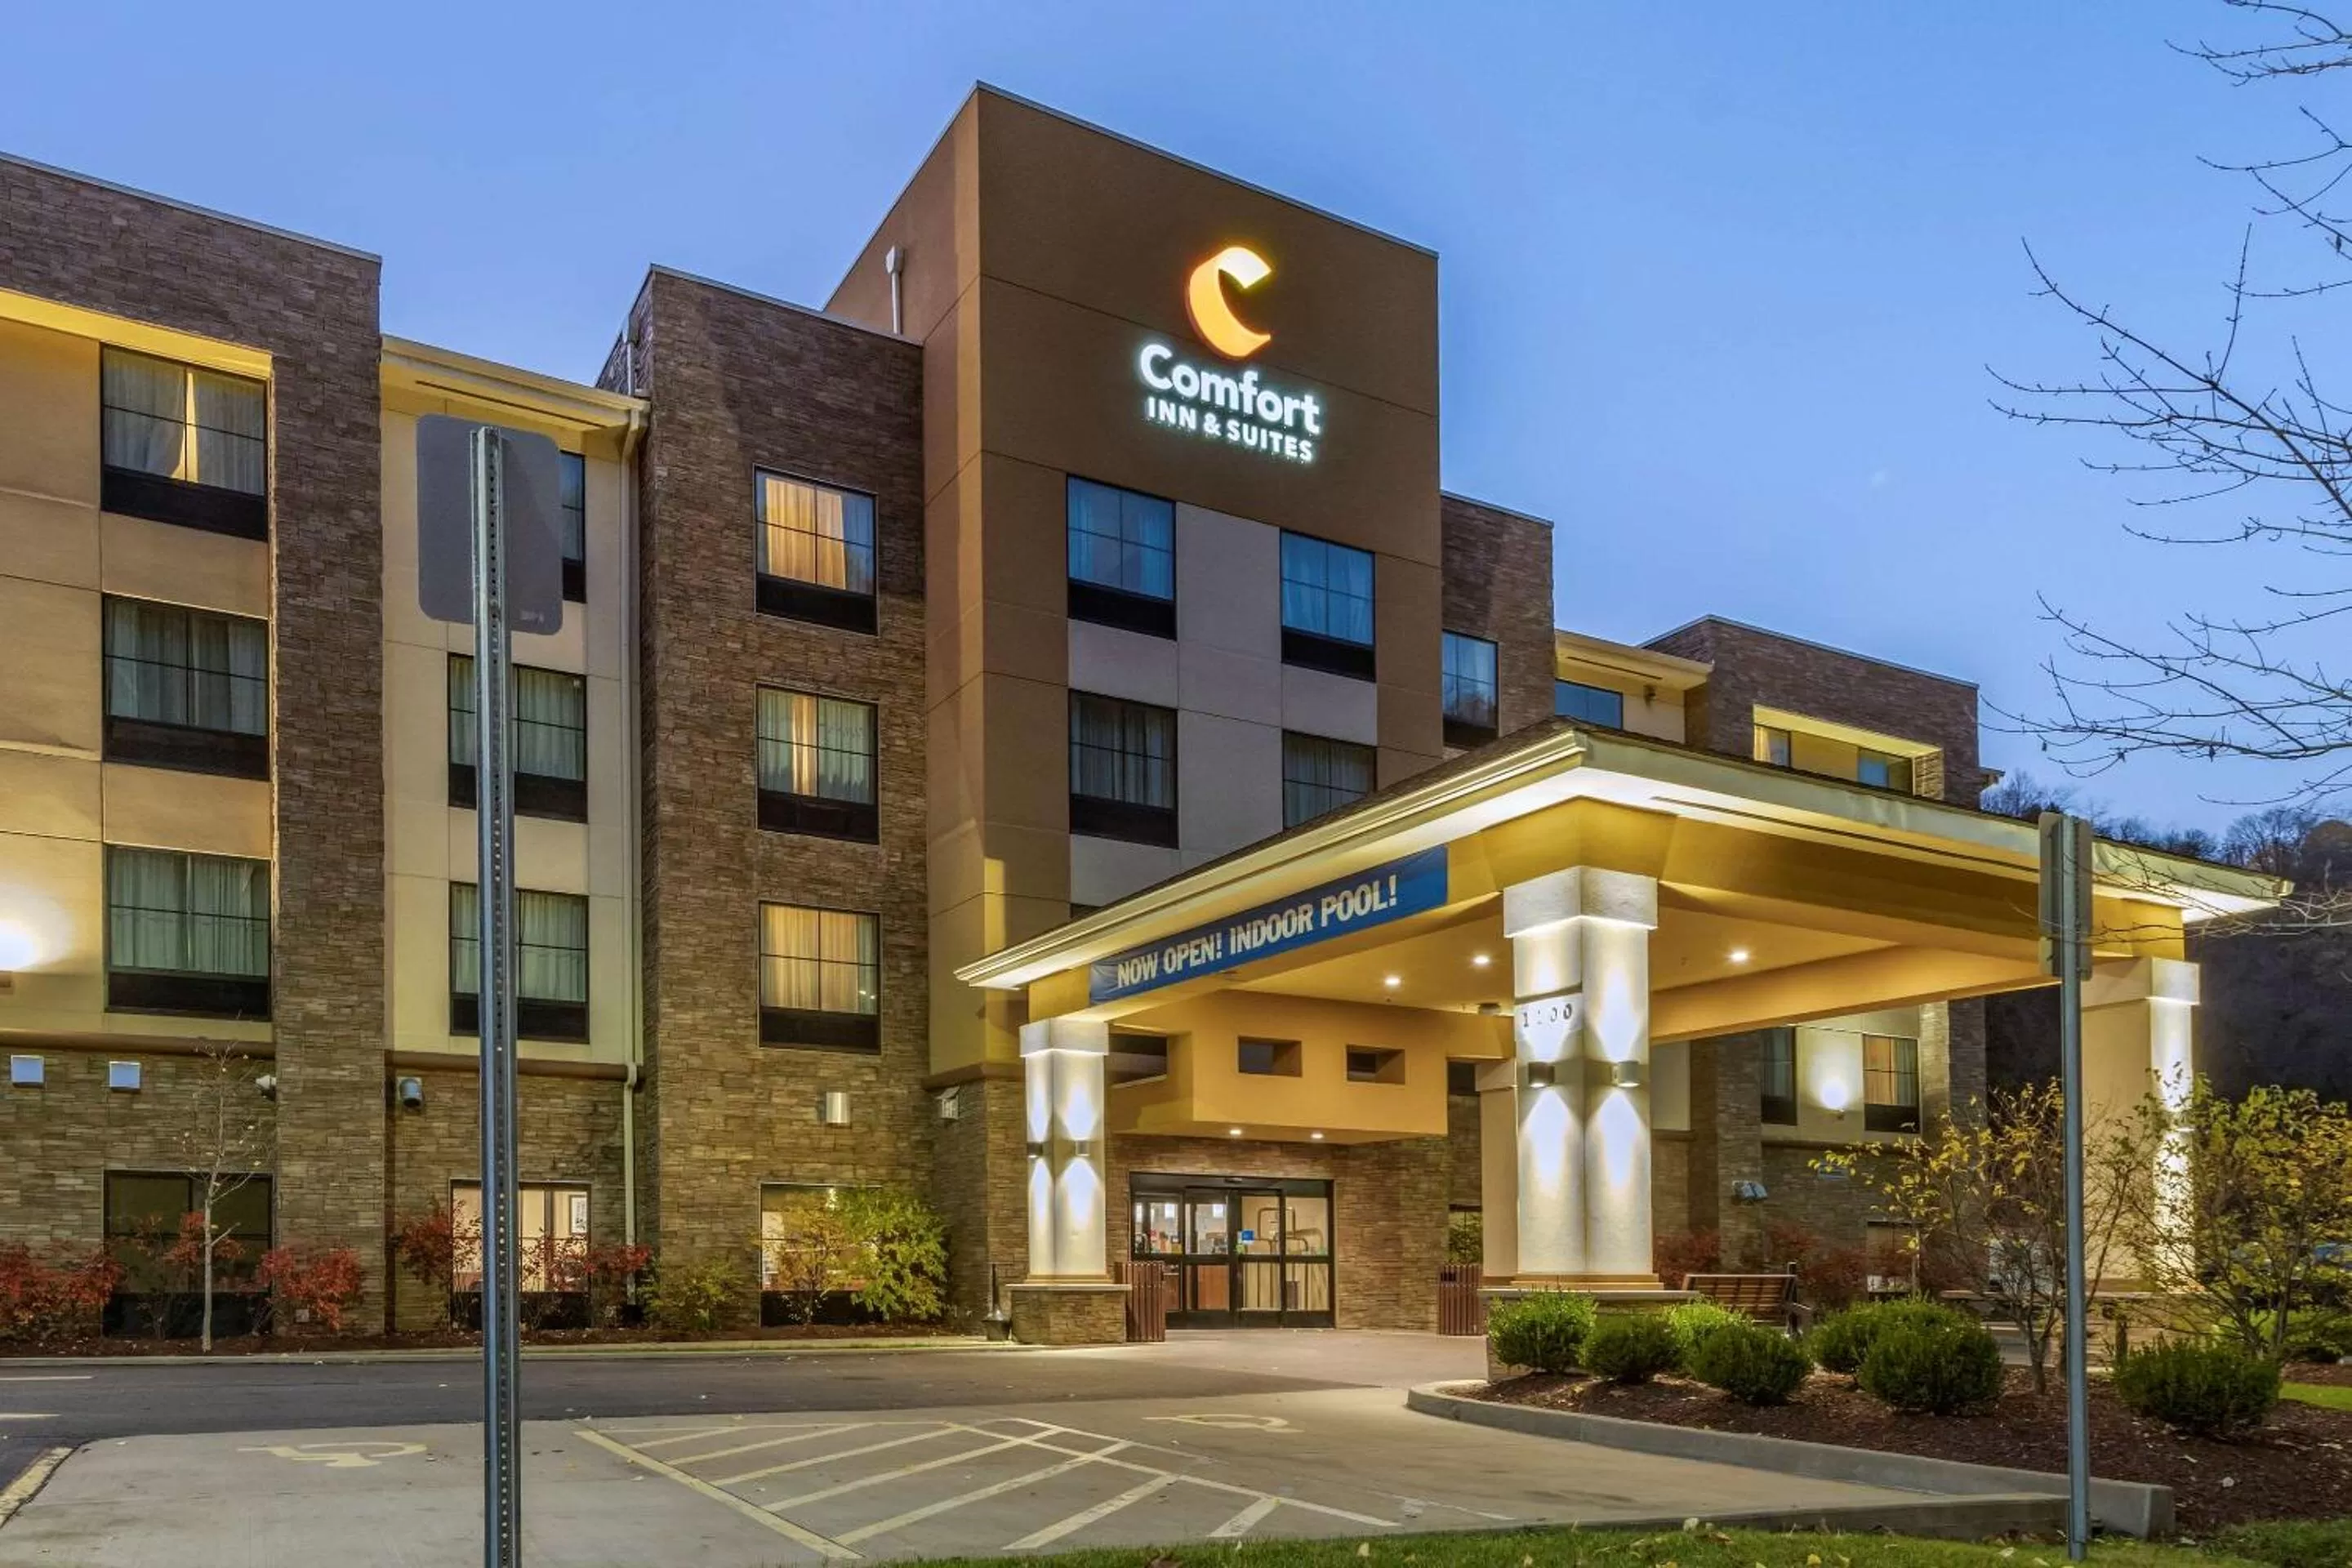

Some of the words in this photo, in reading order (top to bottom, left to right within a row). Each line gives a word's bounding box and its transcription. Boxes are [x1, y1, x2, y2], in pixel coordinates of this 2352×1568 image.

[1140, 343, 1320, 434] Comfort
[1147, 397, 1196, 430] INN
[1203, 412, 1222, 437] &
[1227, 418, 1313, 462] SUITES
[1117, 951, 1158, 988] NOW
[1163, 933, 1223, 974] OPEN!
[1230, 903, 1314, 955] INDOOR
[1321, 875, 1397, 927] POOL!
